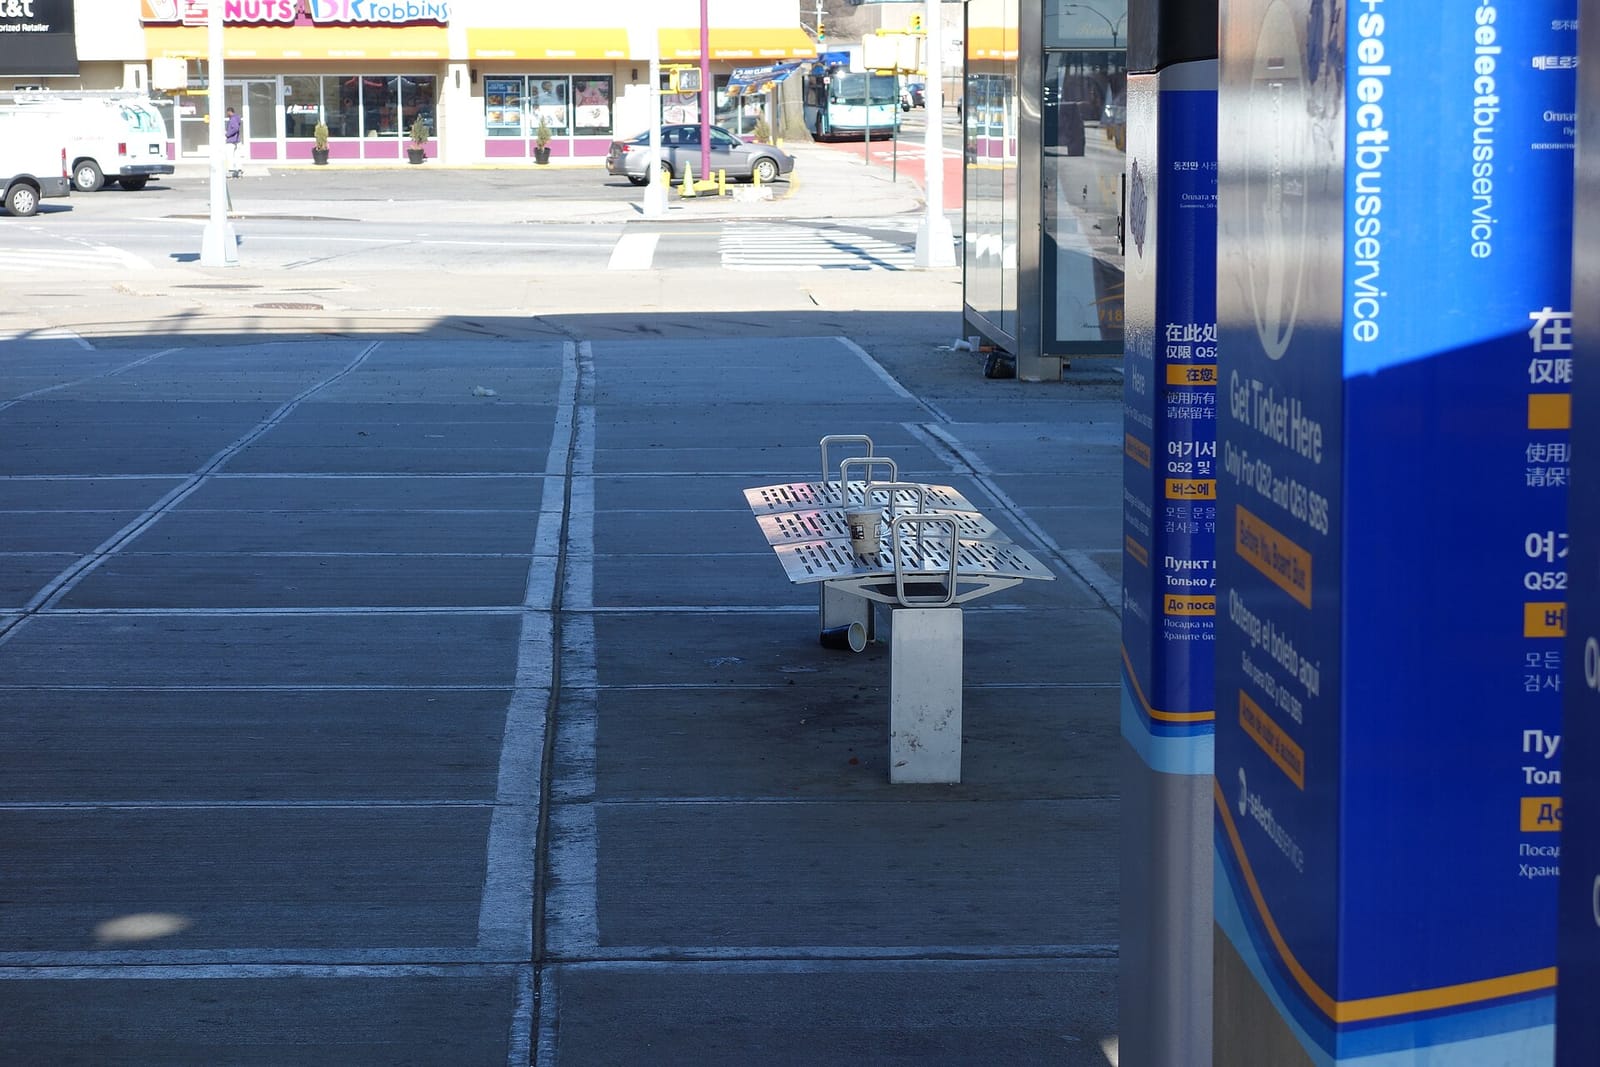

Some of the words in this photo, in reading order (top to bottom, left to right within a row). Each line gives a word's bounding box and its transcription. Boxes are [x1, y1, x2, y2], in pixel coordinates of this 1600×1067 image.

[22, 24, 49, 32] Retailer
[1230, 369, 1250, 426] Get
[1252, 379, 1288, 447] Ticket
[1291, 397, 1322, 465] Here
[1167, 441, 1217, 458] 여기서
[1167, 461, 1193, 473] Q52
[1172, 483, 1209, 496] 버스에
[1225, 440, 1241, 486] Only
[1242, 450, 1255, 487] For
[1255, 459, 1272, 500] Q52
[1272, 477, 1289, 511] and
[1289, 479, 1307, 522] Q53
[1308, 490, 1329, 536] SBS
[1165, 556, 1209, 572] Пункт
[1166, 575, 1208, 587] Только
[1524, 571, 1568, 591] Q52
[1168, 599, 1184, 612] До
[1164, 619, 1200, 630] Посадка
[1202, 621, 1214, 629] на
[1229, 587, 1261, 648] Obtenga
[1263, 619, 1270, 652] el
[1271, 623, 1298, 677] boleto
